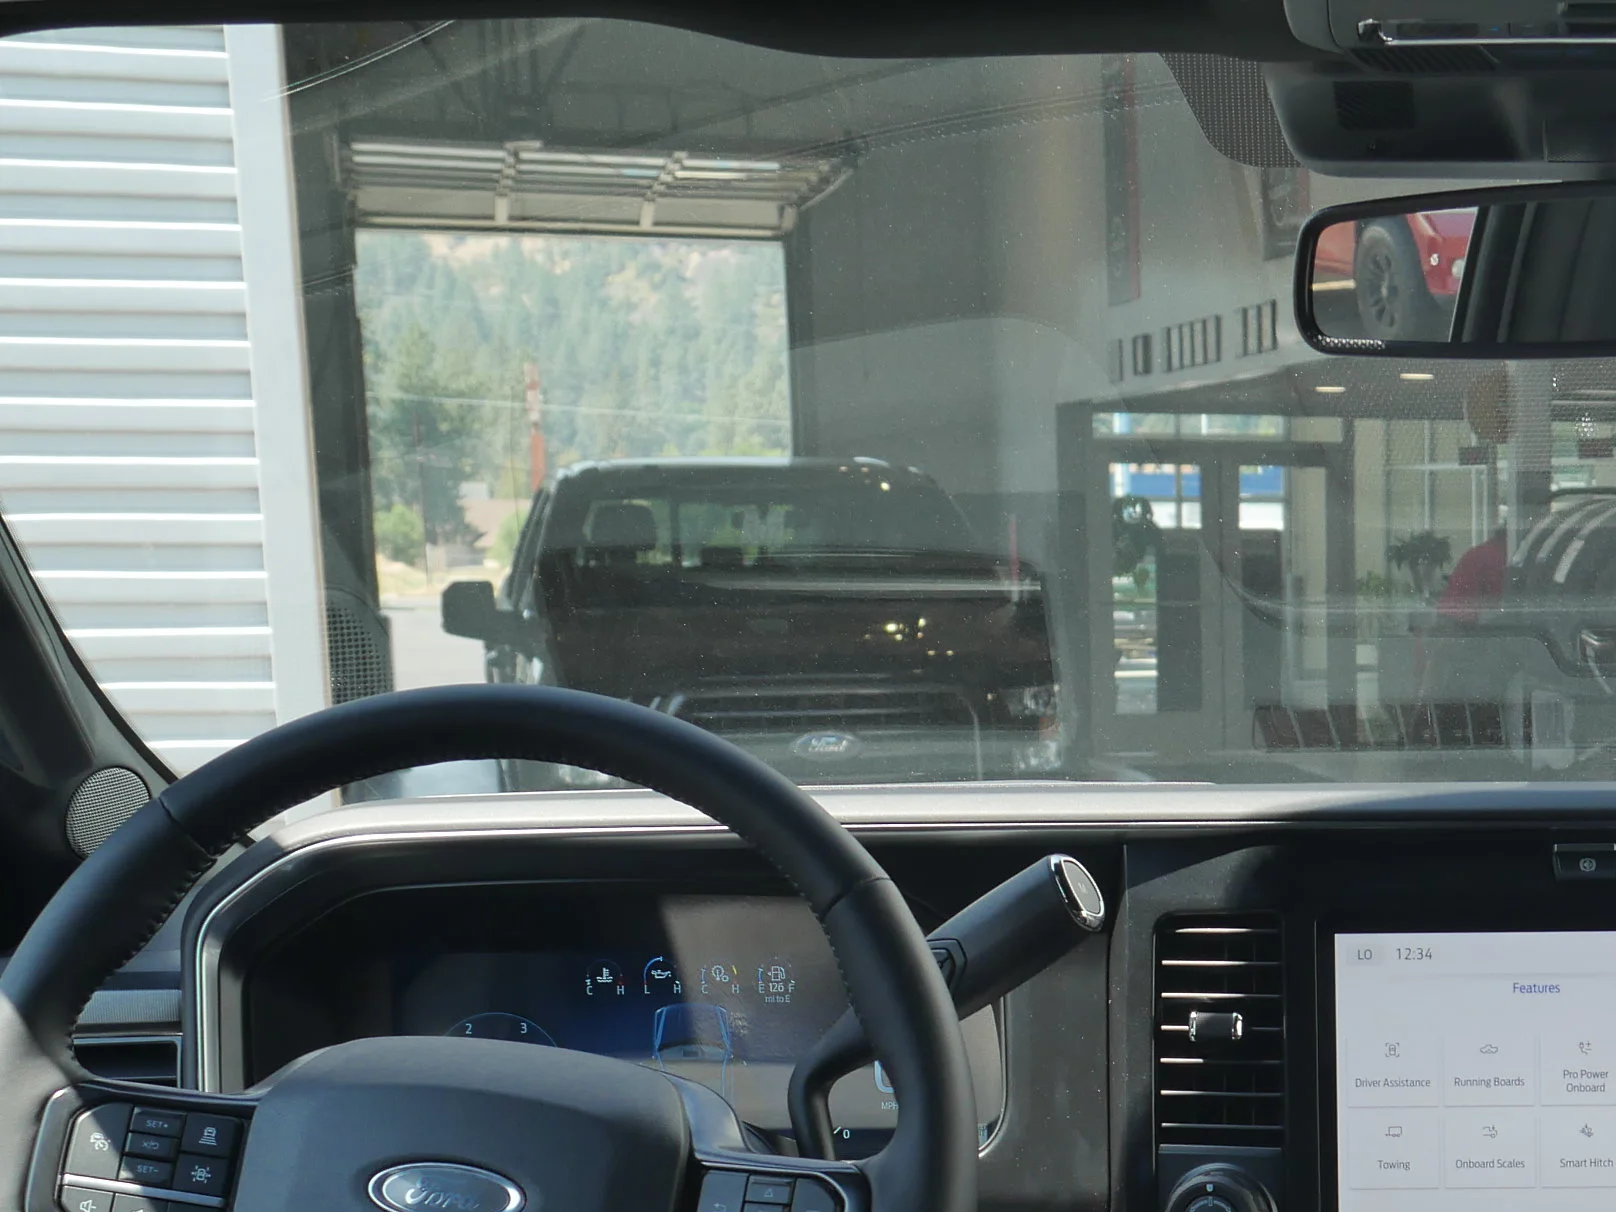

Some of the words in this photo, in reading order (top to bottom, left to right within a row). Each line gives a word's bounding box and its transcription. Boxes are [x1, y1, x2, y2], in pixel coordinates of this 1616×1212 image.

[1357, 949, 1372, 961] LO
[1396, 948, 1432, 961] 12:34
[1513, 982, 1560, 994] Features
[465, 1023, 472, 1035] 2
[520, 1022, 527, 1034] 3
[1563, 1069, 1578, 1079] Pro
[1580, 1069, 1609, 1079] Power
[1355, 1078, 1381, 1088] Driver
[1383, 1078, 1431, 1088] Assistance
[1454, 1077, 1491, 1089] Running
[1493, 1077, 1525, 1087] Boards
[1566, 1083, 1605, 1093] Onboard
[1377, 1160, 1410, 1171] Towing
[1455, 1159, 1495, 1169] Onboard
[1497, 1159, 1525, 1169] Scales
[1560, 1158, 1587, 1168] Smart
[1589, 1158, 1613, 1168] Hitch
